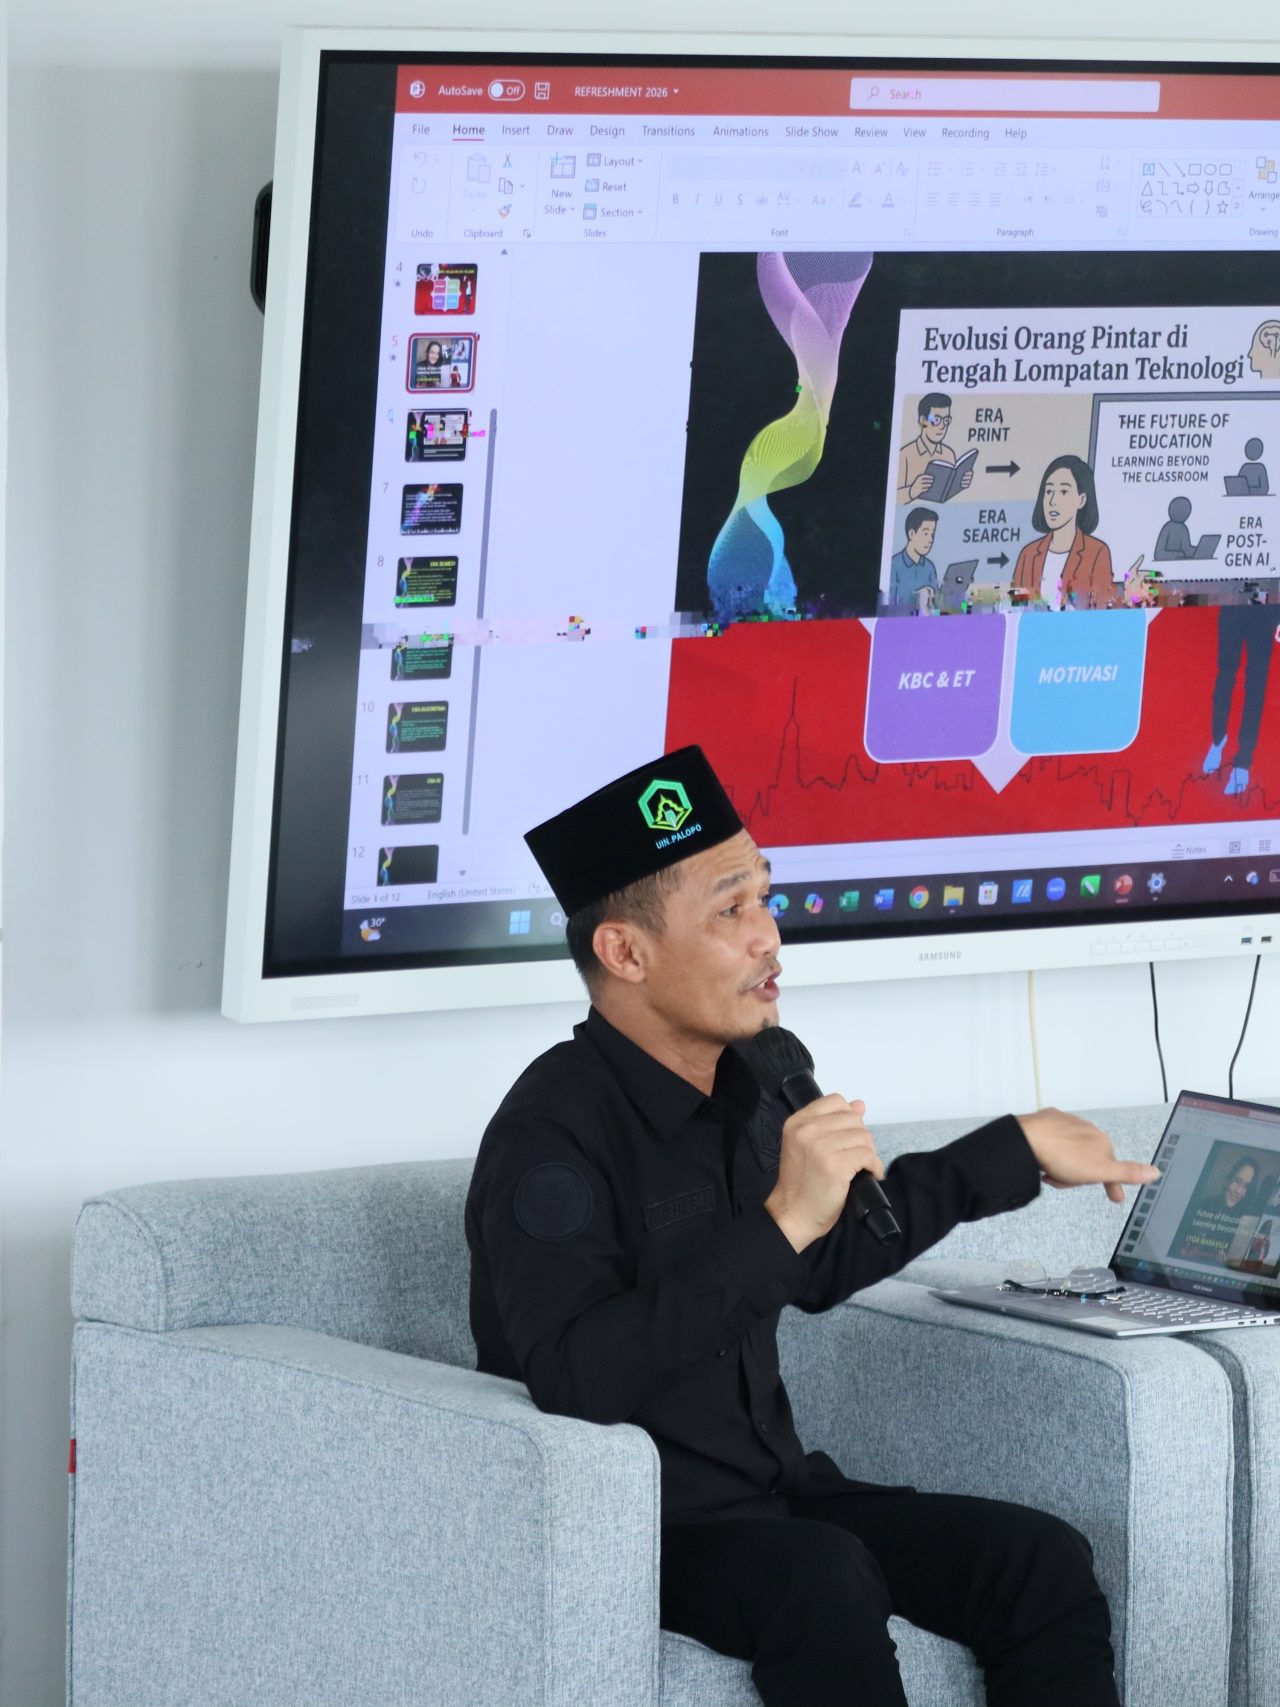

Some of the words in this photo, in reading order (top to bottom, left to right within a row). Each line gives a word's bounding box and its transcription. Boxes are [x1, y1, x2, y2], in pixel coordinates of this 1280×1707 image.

[438, 86, 483, 96] AutoSave
[506, 86, 520, 96] Off
[575, 86, 642, 97] REFRESHMENT
[645, 87, 668, 97] 2026
[412, 125, 430, 135] File
[453, 125, 485, 135] Home
[502, 125, 530, 136] Insert
[547, 125, 574, 136] Draw
[590, 126, 625, 138] Design
[642, 126, 695, 136] Transitions
[713, 126, 769, 137] Animations
[785, 127, 809, 137] Slide
[812, 127, 839, 137] Show
[855, 127, 888, 138] Review
[903, 128, 926, 138] View
[942, 128, 990, 141] Recording
[1005, 128, 1027, 140] Help
[604, 156, 634, 168] Layout
[602, 182, 627, 191] Reset
[551, 189, 572, 198] New
[1249, 190, 1280, 201] Arrange
[544, 205, 567, 215] Slide
[601, 208, 634, 217] Section
[411, 229, 433, 238] Undo
[463, 229, 503, 239] Clipboard
[584, 229, 606, 238] Slides
[771, 229, 788, 237] Font
[996, 228, 1034, 239] Paragraph
[1249, 228, 1279, 239] Drawing
[391, 336, 398, 347] 5
[923, 326, 1008, 351] Evolusi
[1014, 326, 1086, 355] Orang
[1091, 325, 1160, 349] Pintar
[1167, 323, 1188, 348] di
[922, 359, 1008, 389] Tengah
[1013, 357, 1129, 387] Lompatan
[1136, 356, 1244, 384] Teknologi
[975, 408, 1003, 424] ERA
[1118, 414, 1145, 429] THE
[1150, 413, 1207, 429] FUTURE
[1211, 413, 1230, 428] OF
[967, 427, 1010, 442] PRINT
[1129, 433, 1212, 449] EDUCATION
[1112, 455, 1164, 468] LEARNING
[1167, 455, 1210, 467] BEYOND
[1122, 471, 1141, 483] THE
[1144, 471, 1208, 483] CLASSROOM
[979, 509, 1007, 524] ERA
[1239, 516, 1263, 529] ERA
[962, 527, 1020, 543] SEARCH
[1226, 534, 1268, 549] POST-
[377, 556, 384, 567] 8
[1224, 552, 1252, 567] GEN
[1255, 552, 1270, 566] AI
[898, 672, 933, 690] KBC
[936, 671, 950, 688] &
[952, 669, 975, 688] ET
[1038, 664, 1119, 685] MOTIVASI
[361, 702, 375, 713] 10
[655, 838, 670, 850] UIN
[671, 823, 702, 842] PALOPO
[352, 847, 365, 858] 12
[427, 890, 456, 901] English
